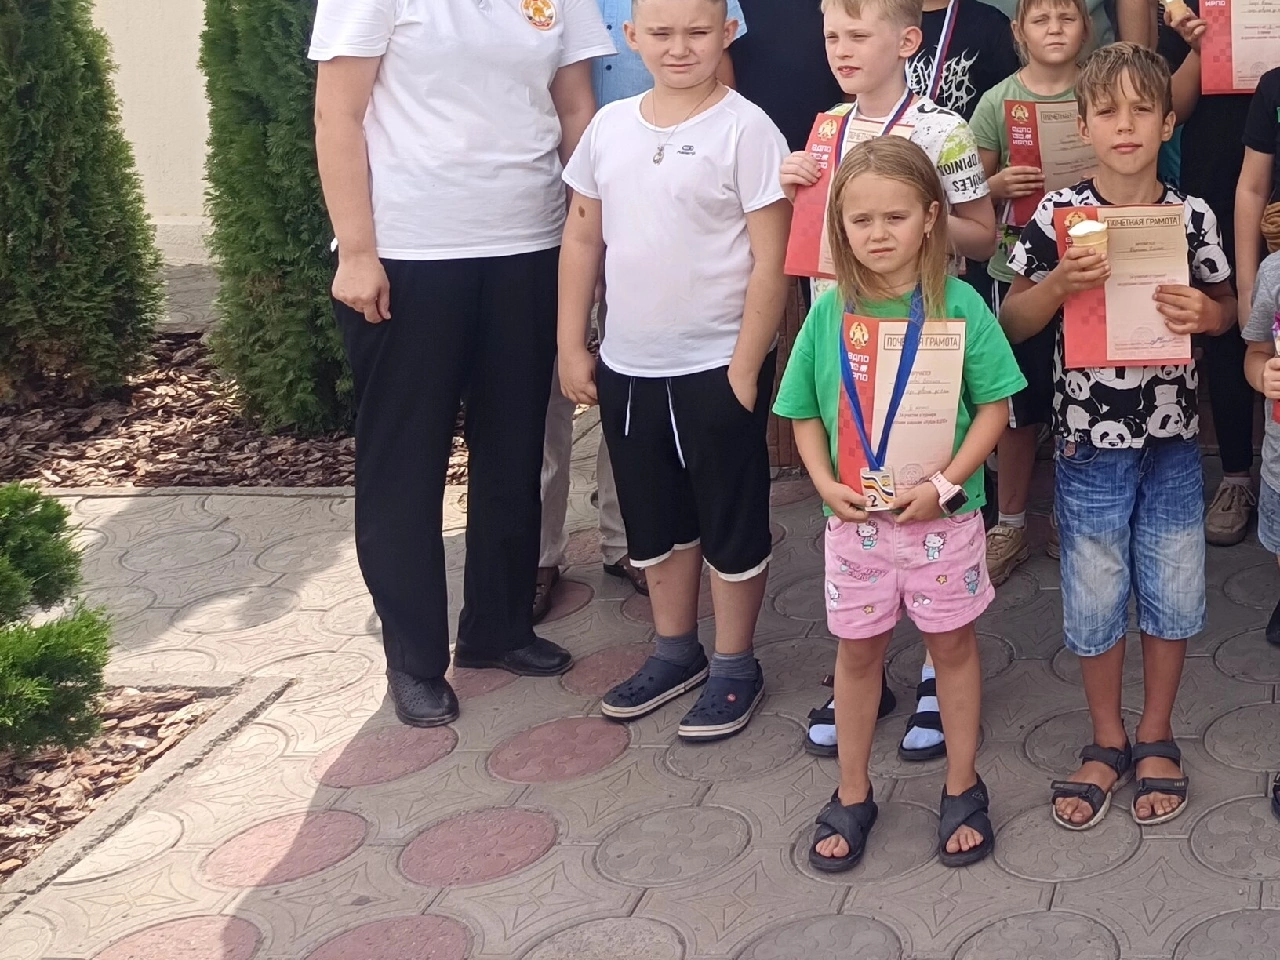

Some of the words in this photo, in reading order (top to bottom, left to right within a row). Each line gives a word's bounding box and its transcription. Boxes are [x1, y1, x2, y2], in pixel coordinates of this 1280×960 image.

[1107, 218, 1144, 228] ПОЧЕТНАЯ
[1145, 217, 1178, 227] ГРАМОТА
[923, 335, 958, 347] ГРАМОТА
[867, 494, 879, 507] 2
